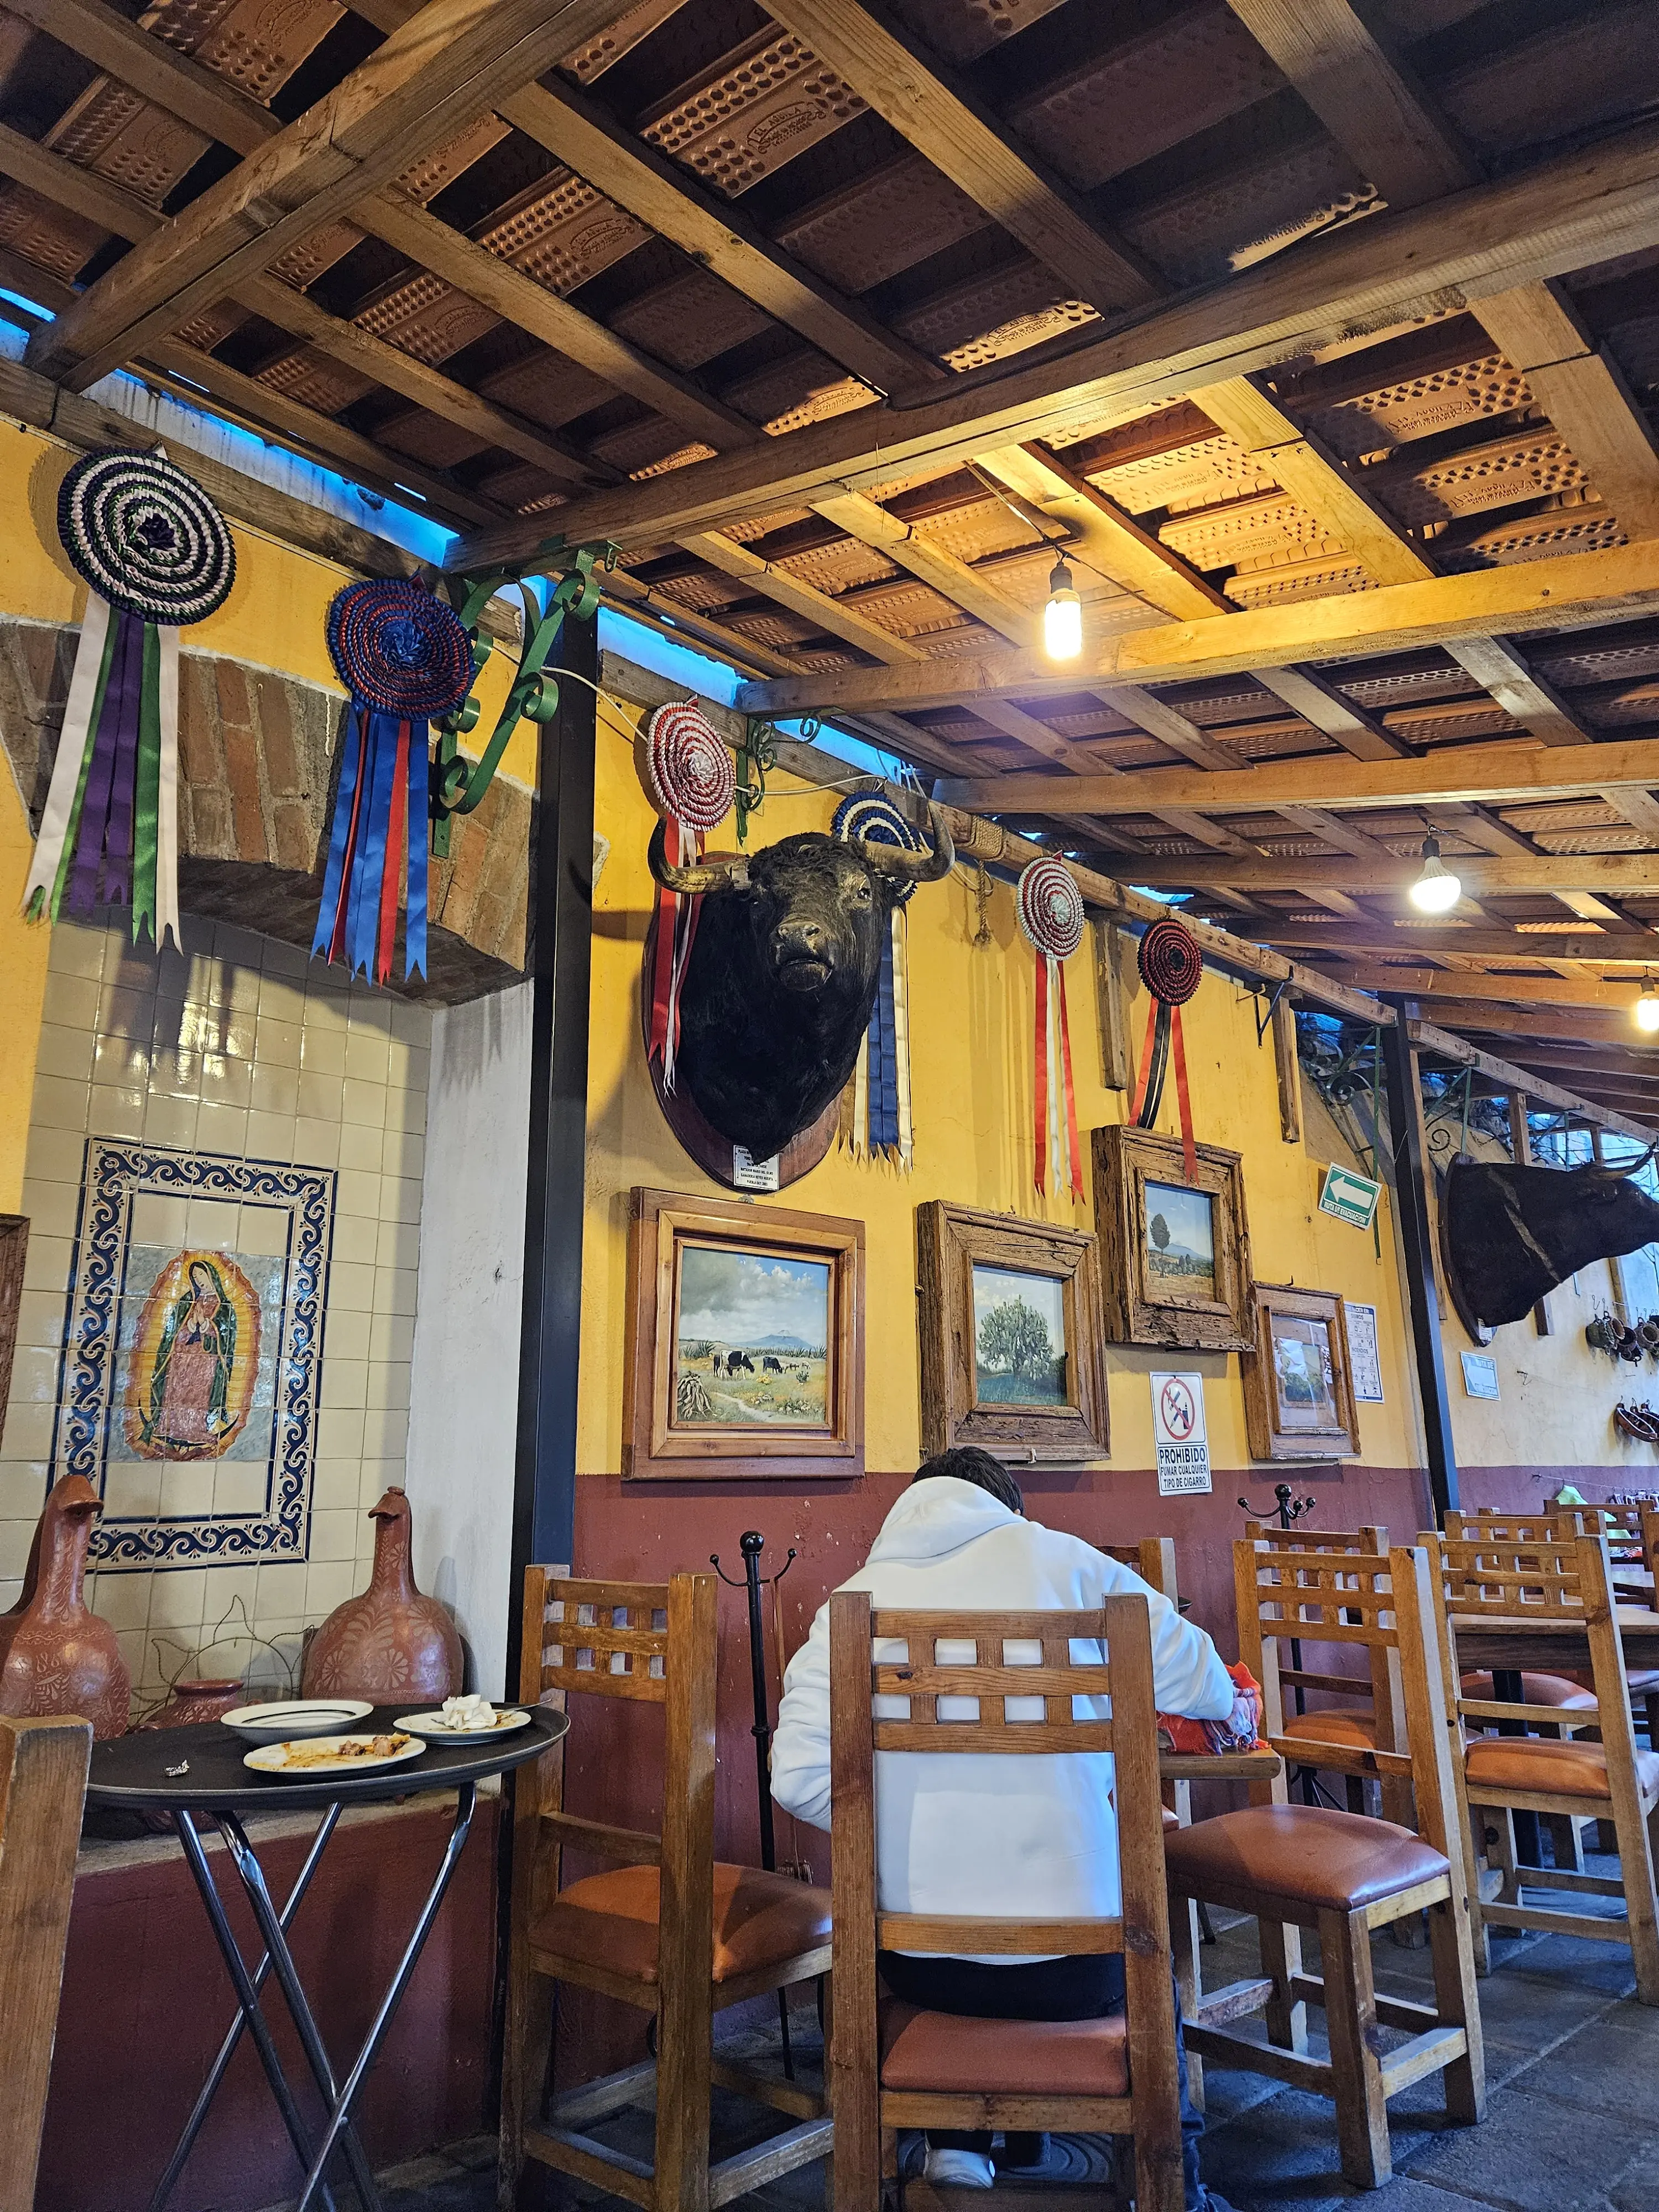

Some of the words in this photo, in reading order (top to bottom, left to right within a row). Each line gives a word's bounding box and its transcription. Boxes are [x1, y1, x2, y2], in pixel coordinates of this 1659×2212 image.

[1324, 1201, 1334, 1211] RUTA
[1334, 1206, 1340, 1214] DE
[1160, 1447, 1206, 1464] PROHIBIDO
[1161, 1466, 1177, 1476] FUMAR
[1178, 1464, 1207, 1475] CUALQUIER
[1164, 1478, 1175, 1488] TIPO
[1176, 1478, 1182, 1487] DE
[1183, 1476, 1206, 1487] CIGARRO
